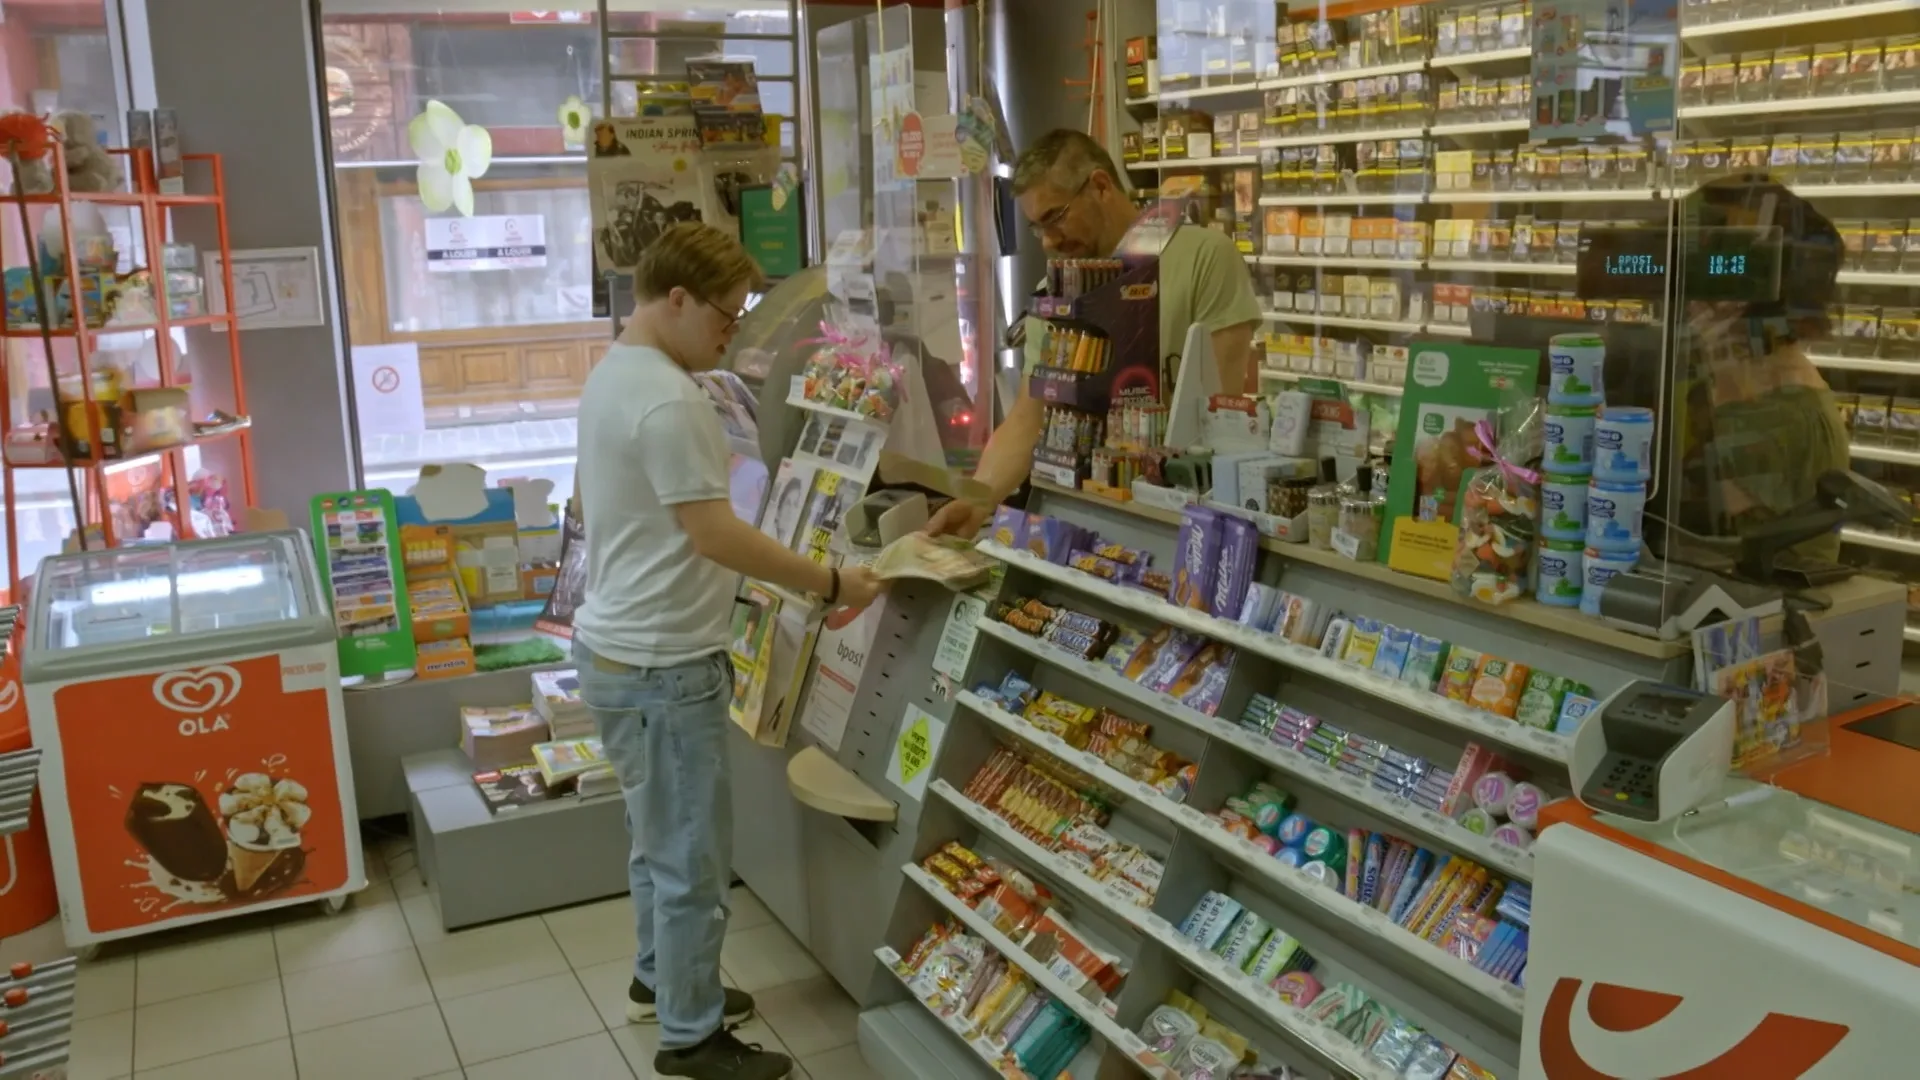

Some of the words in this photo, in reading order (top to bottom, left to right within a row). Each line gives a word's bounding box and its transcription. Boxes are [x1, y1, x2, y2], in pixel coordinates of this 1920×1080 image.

[626, 128, 663, 139] INDIAN
[667, 127, 701, 138] SPRIN
[1189, 523, 1204, 575] Milka
[1214, 546, 1229, 613] Milka
[282, 666, 305, 676] PRESS
[306, 663, 326, 673] SHOP
[836, 639, 864, 669] bpost
[178, 714, 229, 737] OLA
[1363, 866, 1378, 904] entos
[1194, 898, 1226, 944] ORTLIFE
[1223, 916, 1255, 962] ORTLIFE
[1251, 935, 1283, 979] RTLIFE
